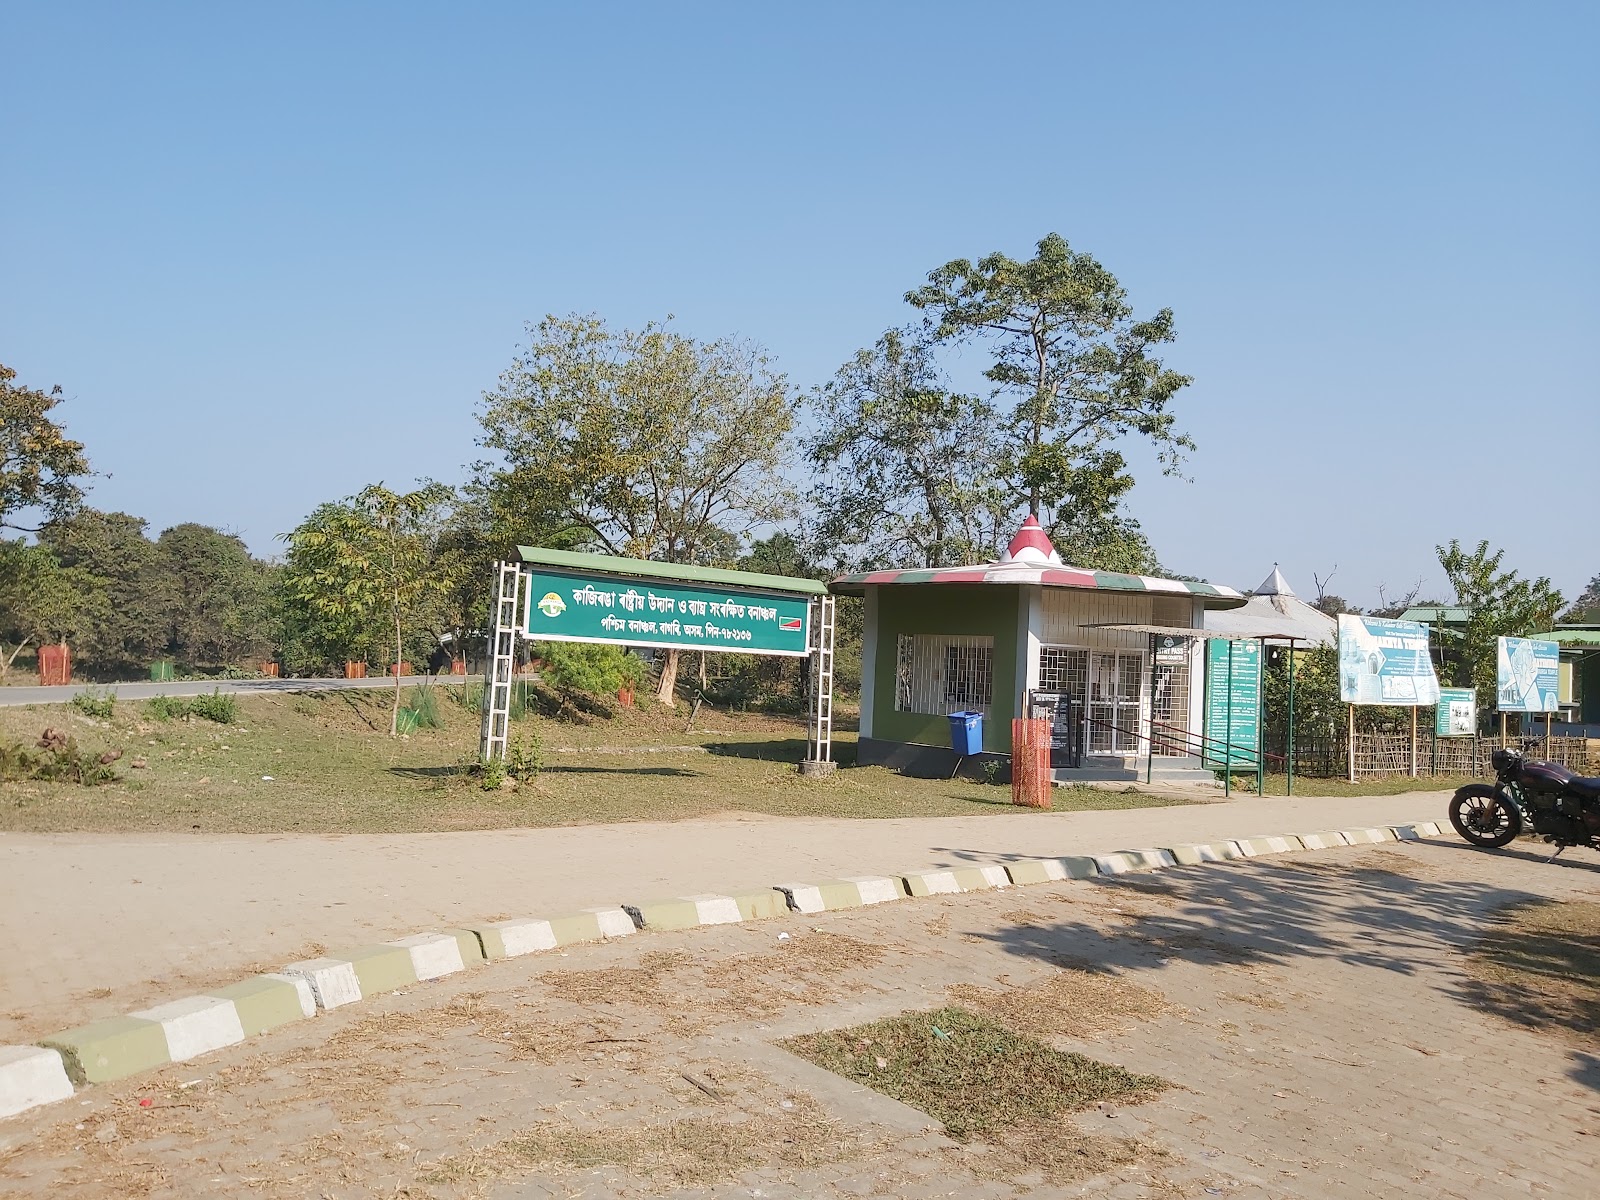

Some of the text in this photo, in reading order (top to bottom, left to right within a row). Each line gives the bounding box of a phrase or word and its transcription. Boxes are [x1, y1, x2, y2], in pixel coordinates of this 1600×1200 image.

[572, 584, 616, 608] কাজিৰঙা
[648, 591, 675, 613] উদ্যান
[678, 600, 686, 613] ও
[601, 613, 626, 632] পশ্চিম
